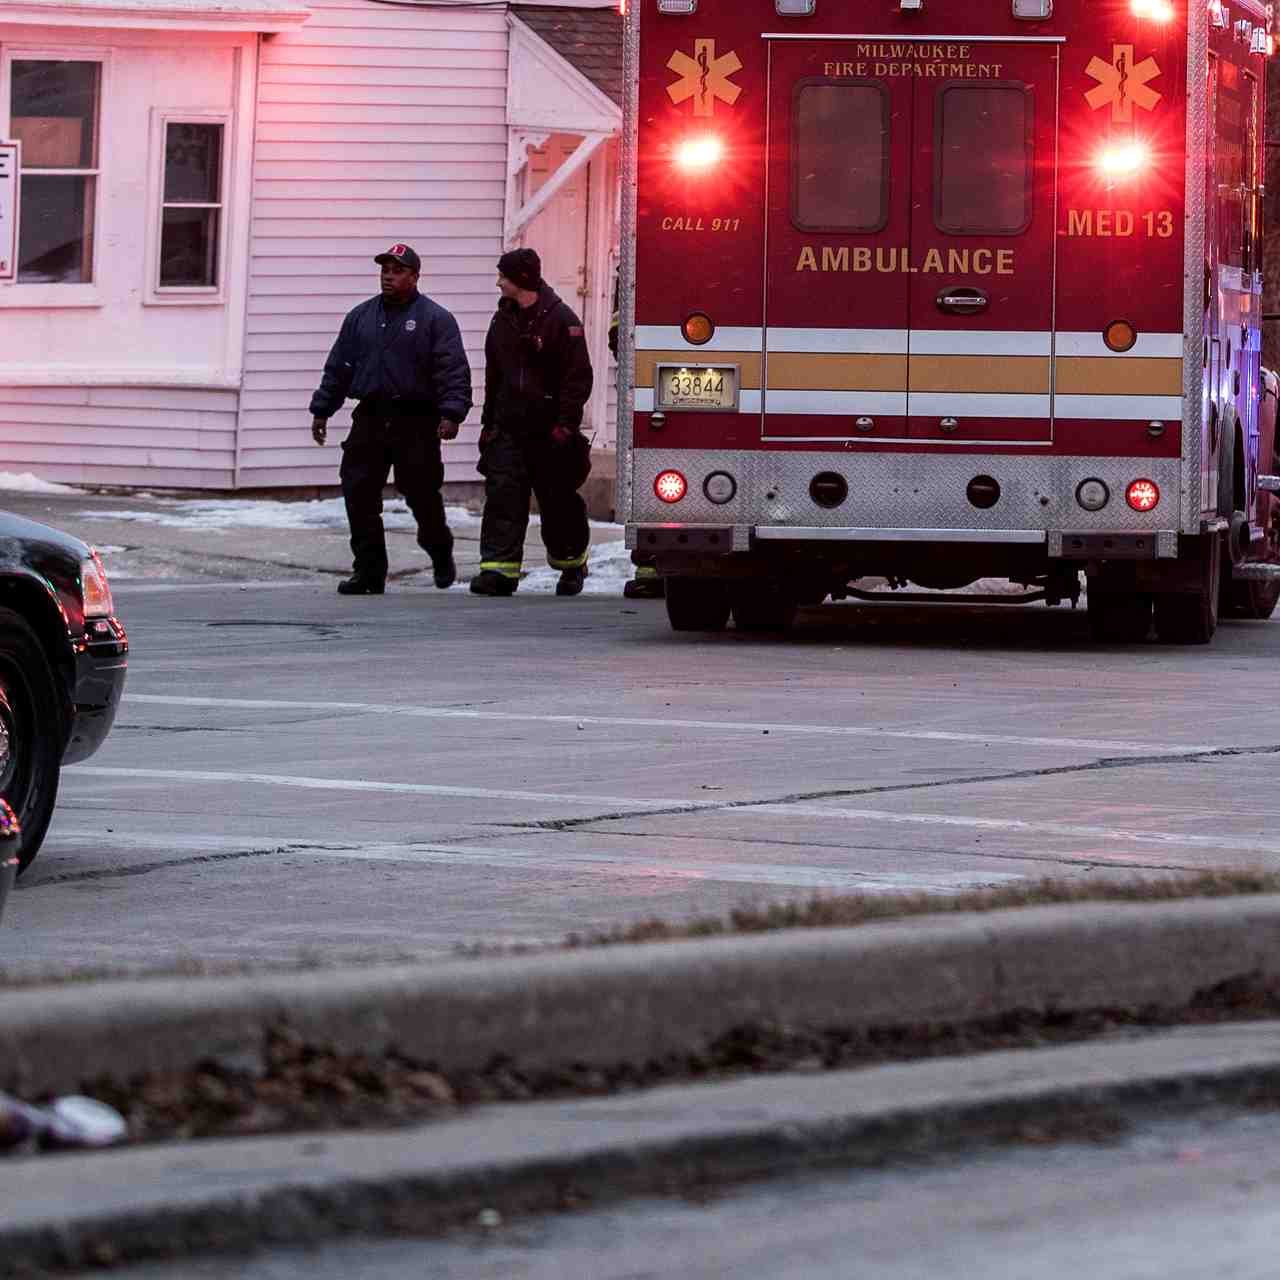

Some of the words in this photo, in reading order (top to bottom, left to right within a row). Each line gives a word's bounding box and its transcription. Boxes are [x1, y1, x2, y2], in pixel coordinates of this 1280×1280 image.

[857, 44, 970, 59] MILWAUKEE
[824, 62, 867, 76] FIRE
[875, 63, 1002, 78] DEPARTMENT
[662, 217, 705, 231] CALL
[711, 218, 740, 232] 911
[1068, 209, 1134, 237] MED
[1142, 211, 1173, 238] 13
[796, 246, 1015, 275] AMBULANCE
[671, 376, 724, 395] 33844
